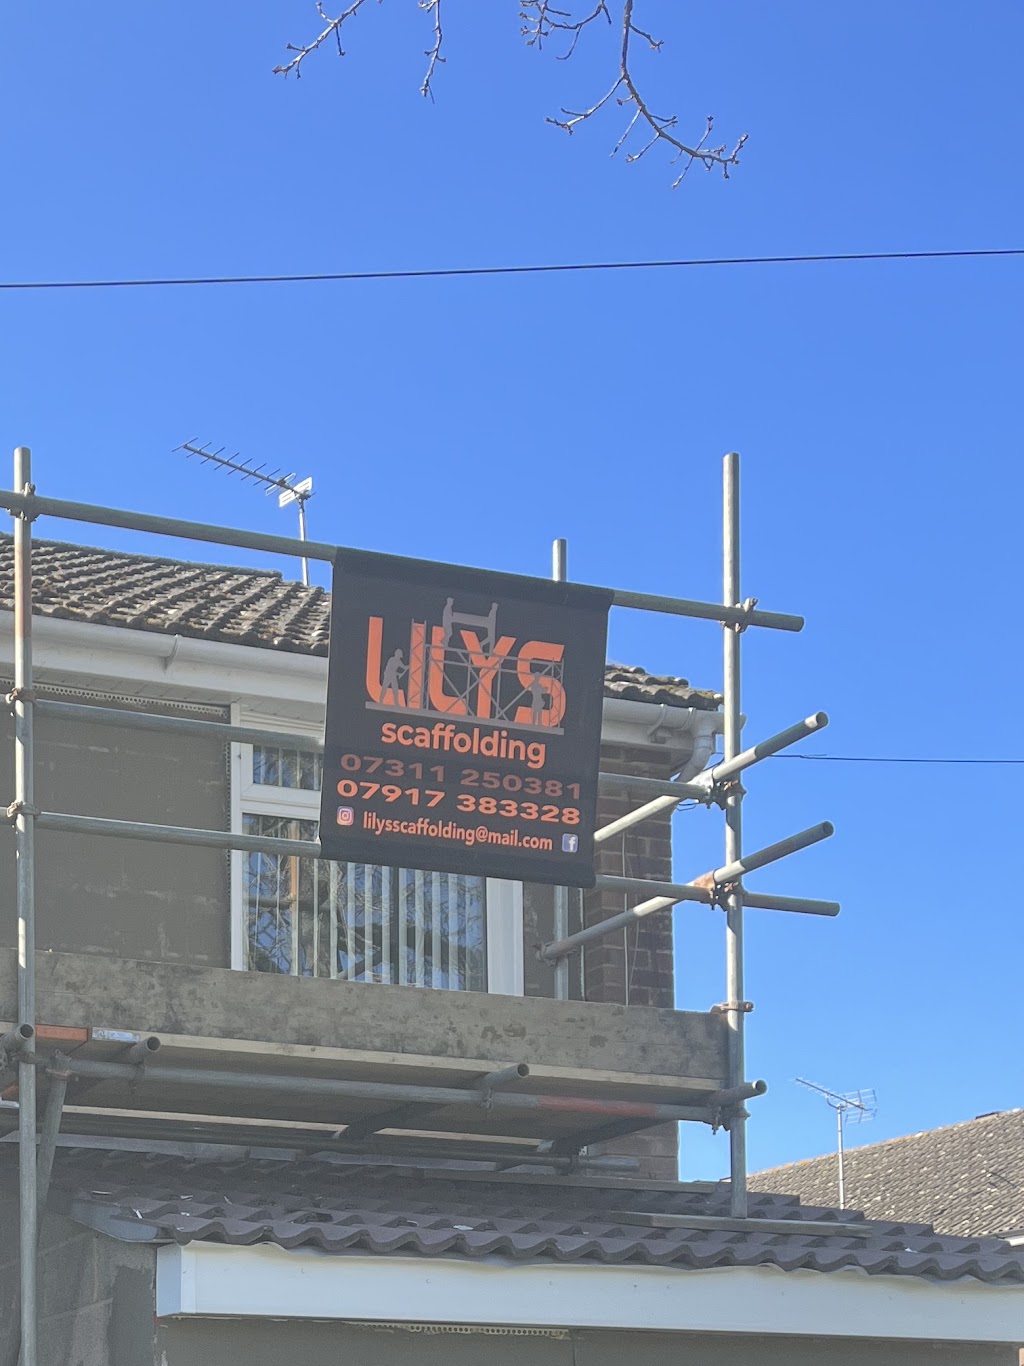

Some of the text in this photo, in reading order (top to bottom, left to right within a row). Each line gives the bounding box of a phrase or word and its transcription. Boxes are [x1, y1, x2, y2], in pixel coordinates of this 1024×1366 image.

[365, 616, 567, 728] LILYS
[381, 722, 546, 768] scaffolding
[340, 753, 580, 800] 07311 250381
[337, 779, 581, 824] 07917 383328
[362, 811, 553, 850] lilysscaffolding@mail.com
